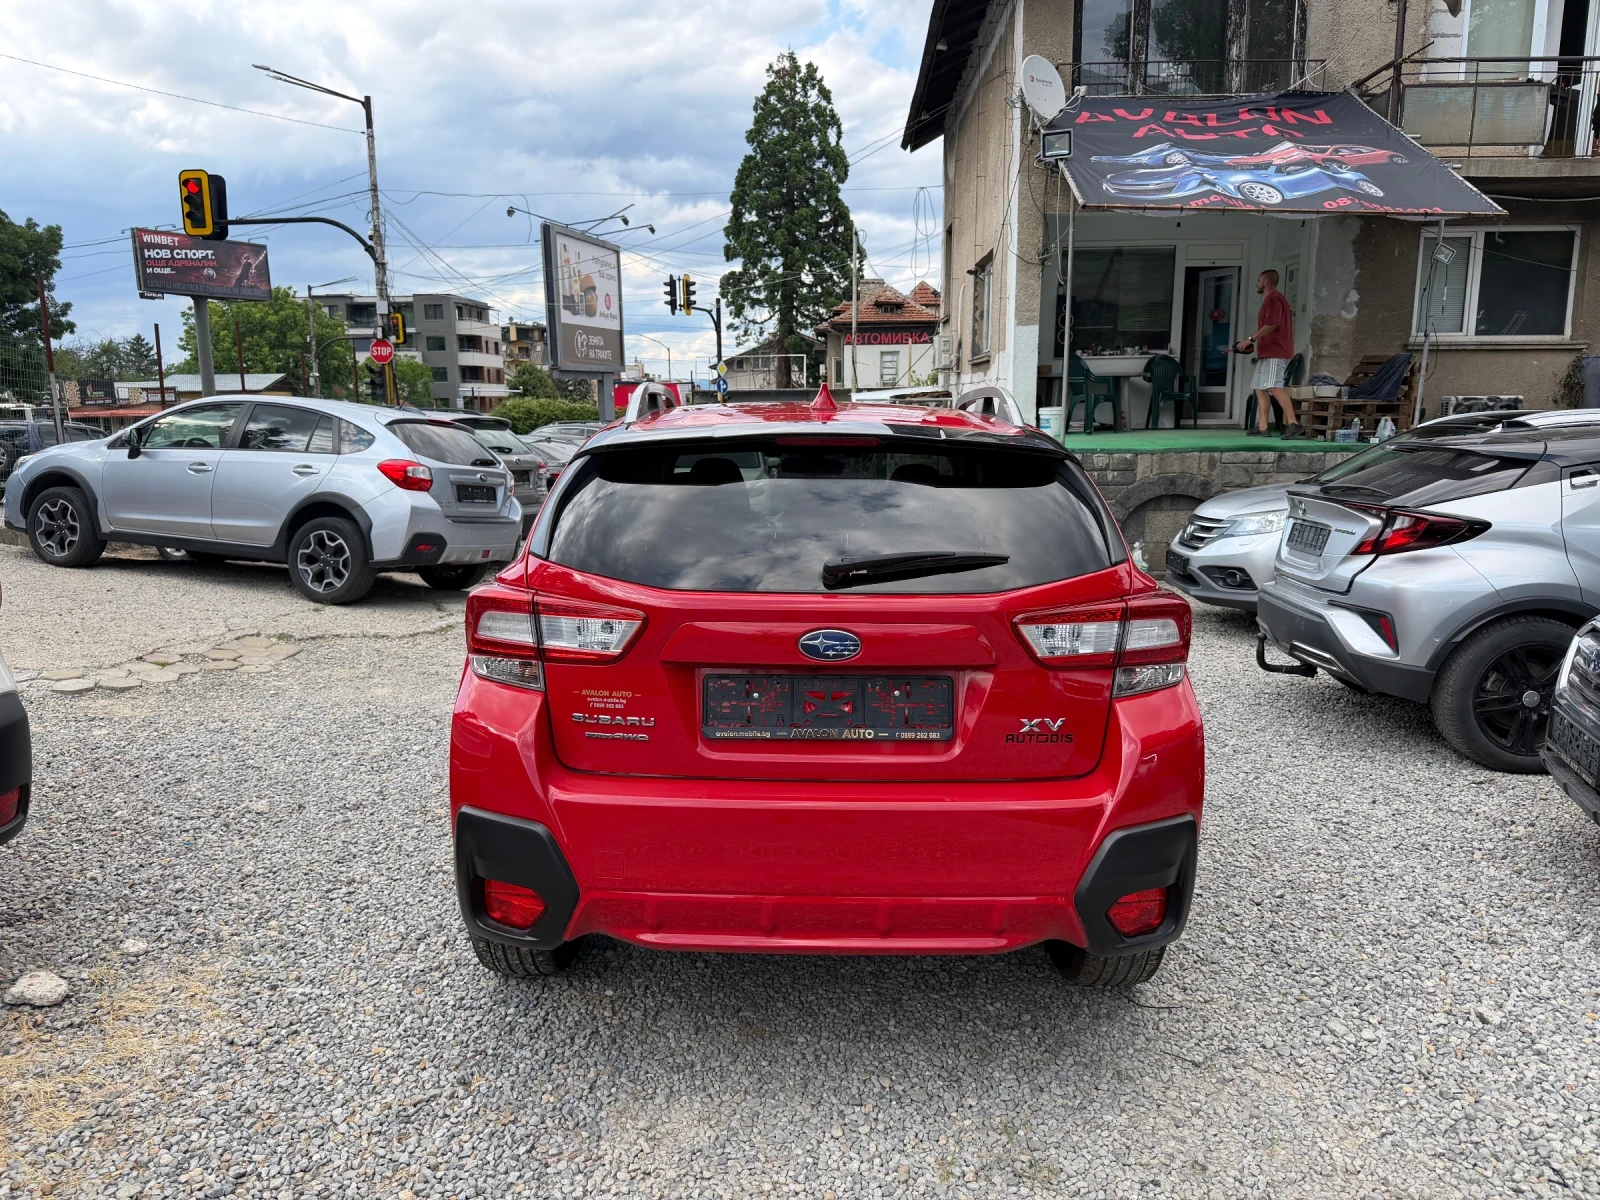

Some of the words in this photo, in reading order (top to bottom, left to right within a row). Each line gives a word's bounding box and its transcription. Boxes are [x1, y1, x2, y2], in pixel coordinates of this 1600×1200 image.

[142, 233, 179, 246] WINBET
[144, 249, 171, 259] НОВ
[173, 249, 215, 259] СПОРТ.
[146, 259, 167, 267] ОЩЕ
[843, 331, 931, 345] АВТОМИВКА
[372, 346, 392, 356] STOP
[581, 689, 610, 697] AVALON
[611, 690, 633, 698] AUTO
[571, 713, 656, 727] SUBARU
[1019, 717, 1067, 733] XV
[715, 730, 771, 738] avalon.mobile.bg
[790, 728, 839, 738] AVALON
[841, 728, 875, 739] AUTO
[1005, 733, 1075, 744] AUTODIS
